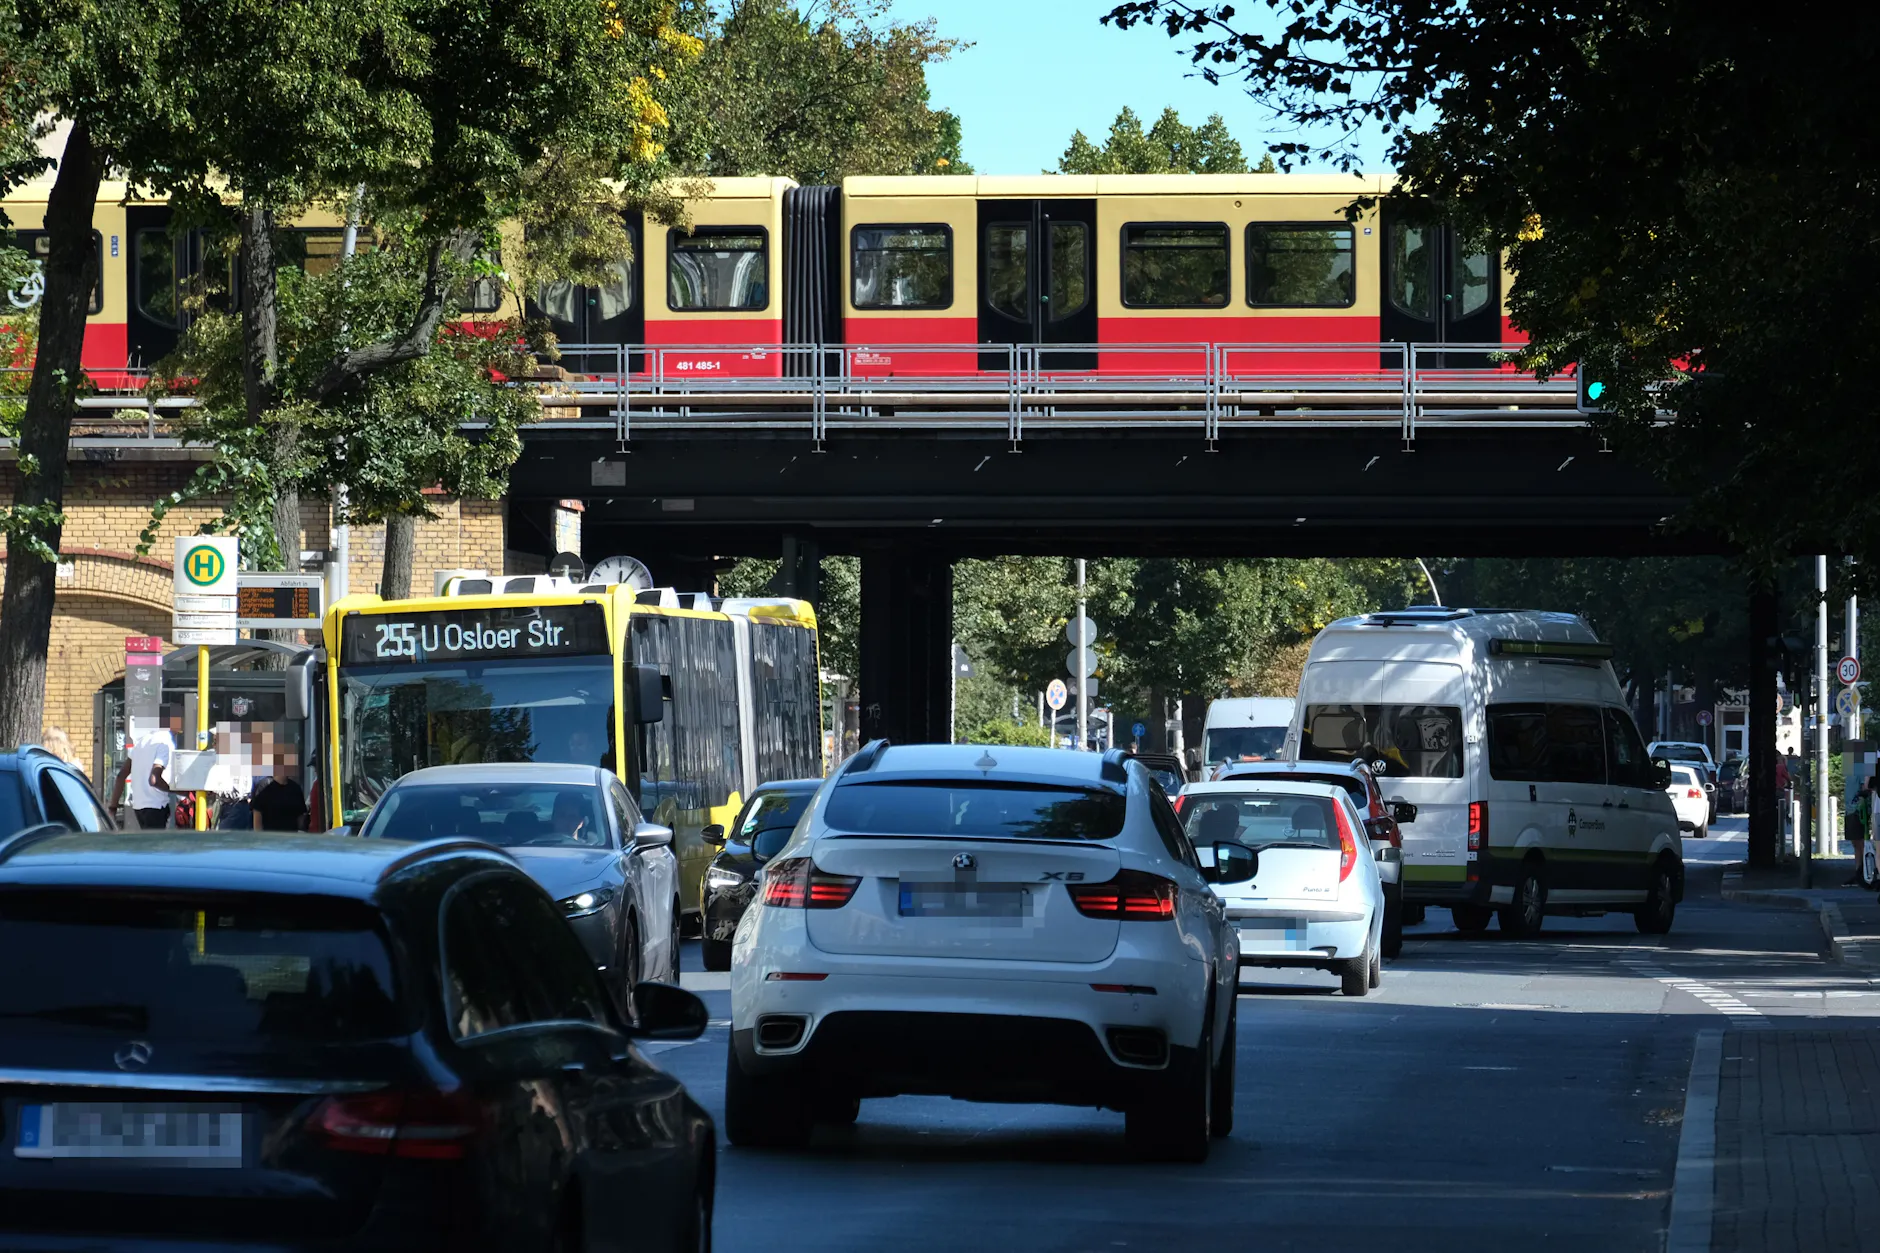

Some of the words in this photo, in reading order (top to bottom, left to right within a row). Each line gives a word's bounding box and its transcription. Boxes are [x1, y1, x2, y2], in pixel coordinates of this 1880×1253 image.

[676, 361, 693, 370] 481
[695, 361, 721, 370] 485-1
[194, 554, 214, 577] H
[375, 622, 416, 657] 255
[421, 624, 439, 652] U
[444, 622, 521, 651] Osloer
[527, 619, 570, 648] Str.
[1842, 664, 1855, 677] 30
